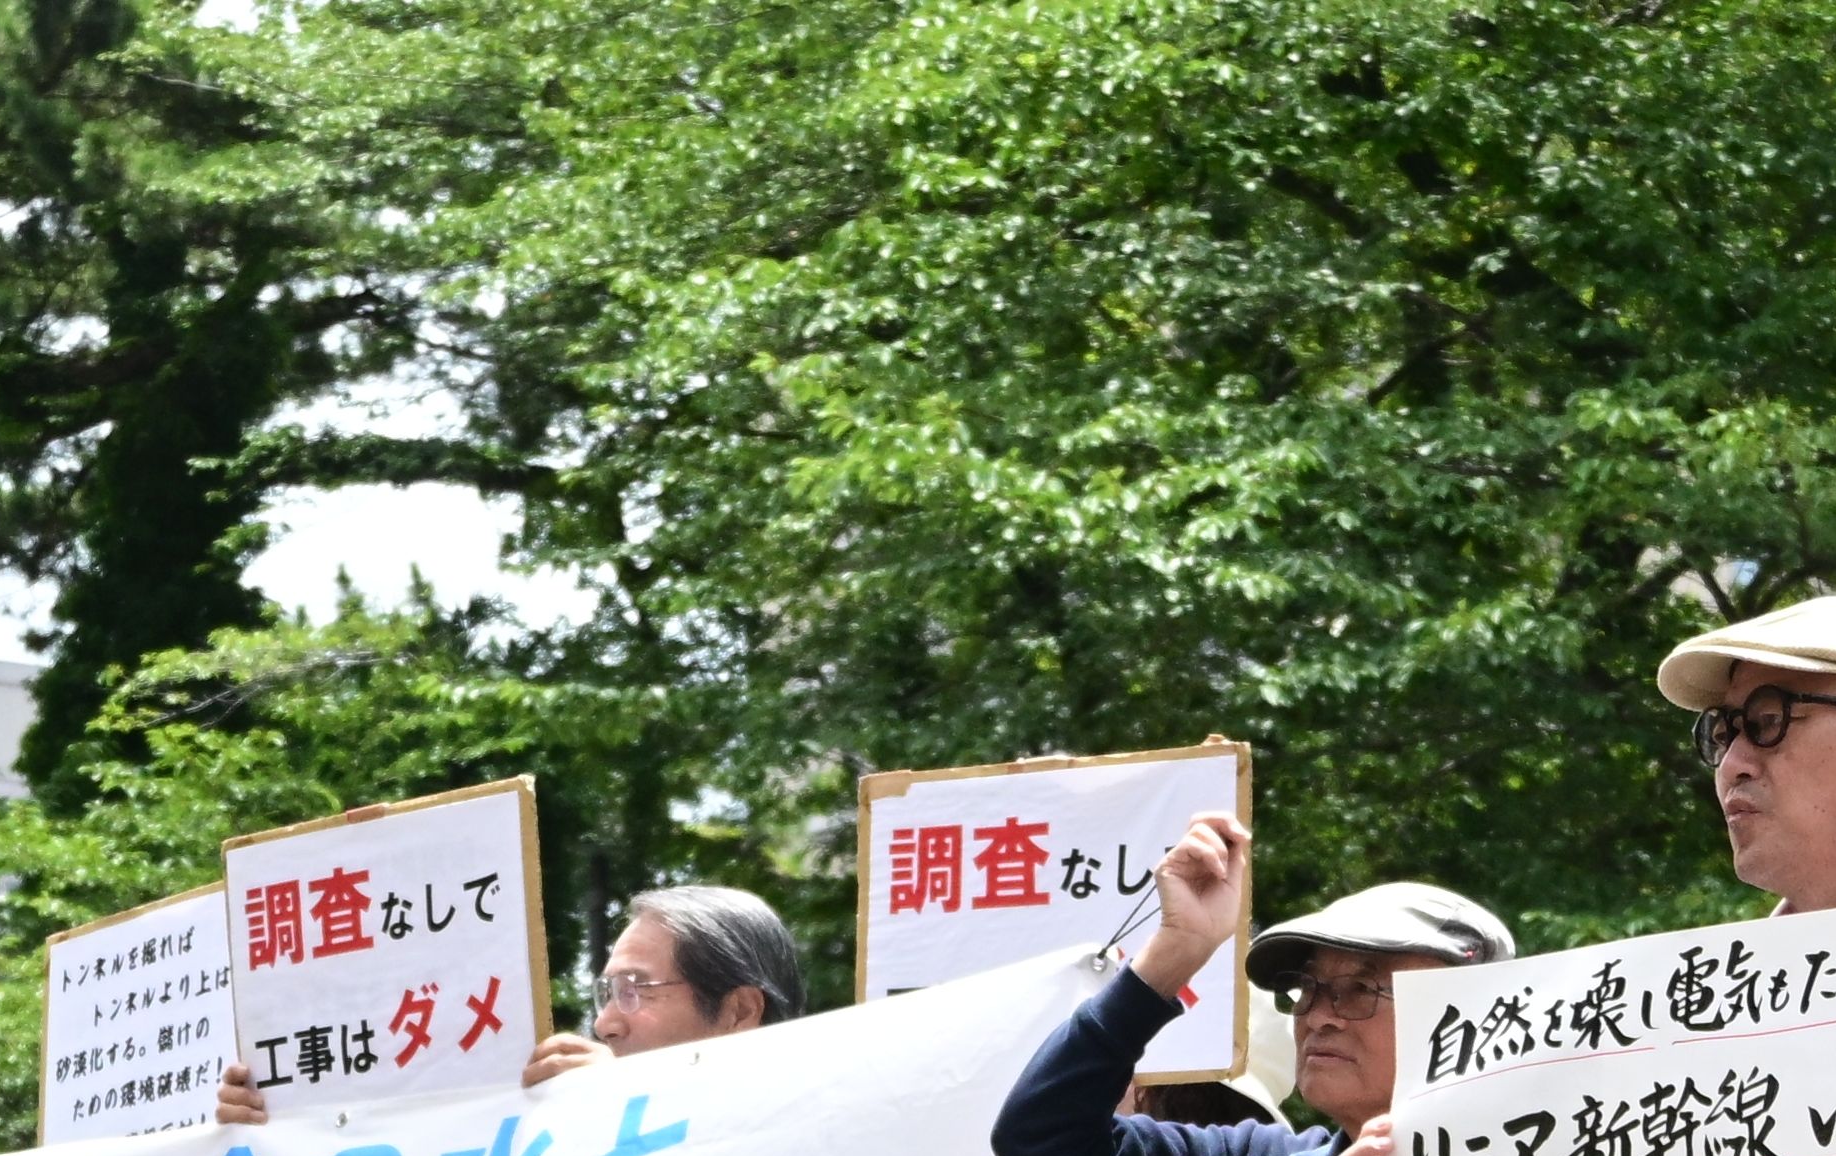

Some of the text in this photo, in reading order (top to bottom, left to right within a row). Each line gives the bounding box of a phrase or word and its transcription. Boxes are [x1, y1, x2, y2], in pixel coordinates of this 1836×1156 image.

[889, 817, 1175, 914] 調査なし
[62, 925, 195, 992] トンネルを掘れば
[244, 866, 500, 972] 調査なしで
[93, 966, 231, 1027] トンネルより上は
[254, 976, 504, 1089] 工事はダメ
